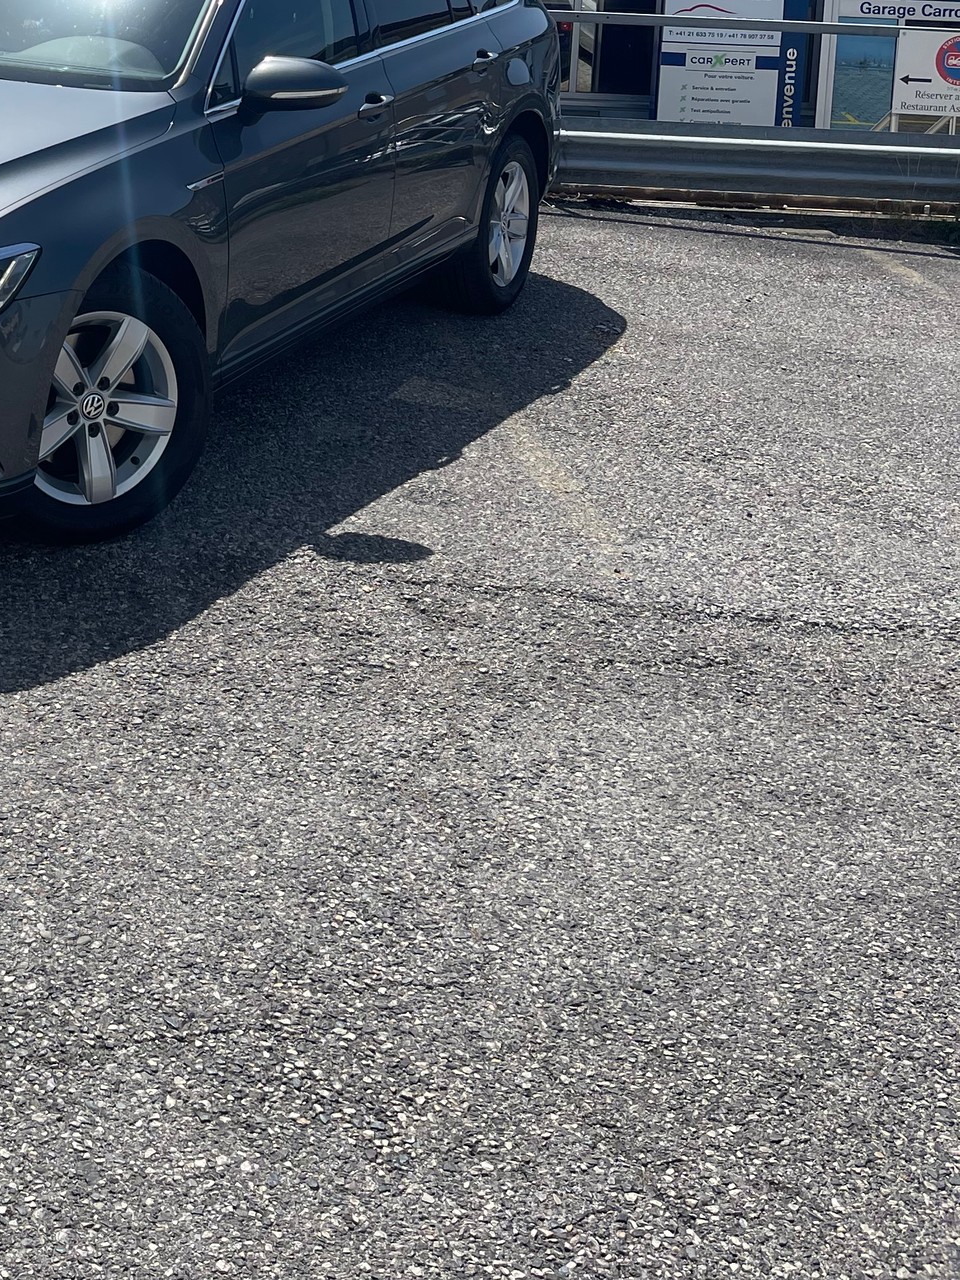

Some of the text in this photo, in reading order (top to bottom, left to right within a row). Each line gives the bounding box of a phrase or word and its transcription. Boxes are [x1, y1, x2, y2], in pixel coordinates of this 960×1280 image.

[860, 1, 960, 19] Garage Carro
[781, 48, 797, 128] envenue
[915, 90, 953, 101] Réserver
[900, 102, 947, 112] Restaurant
